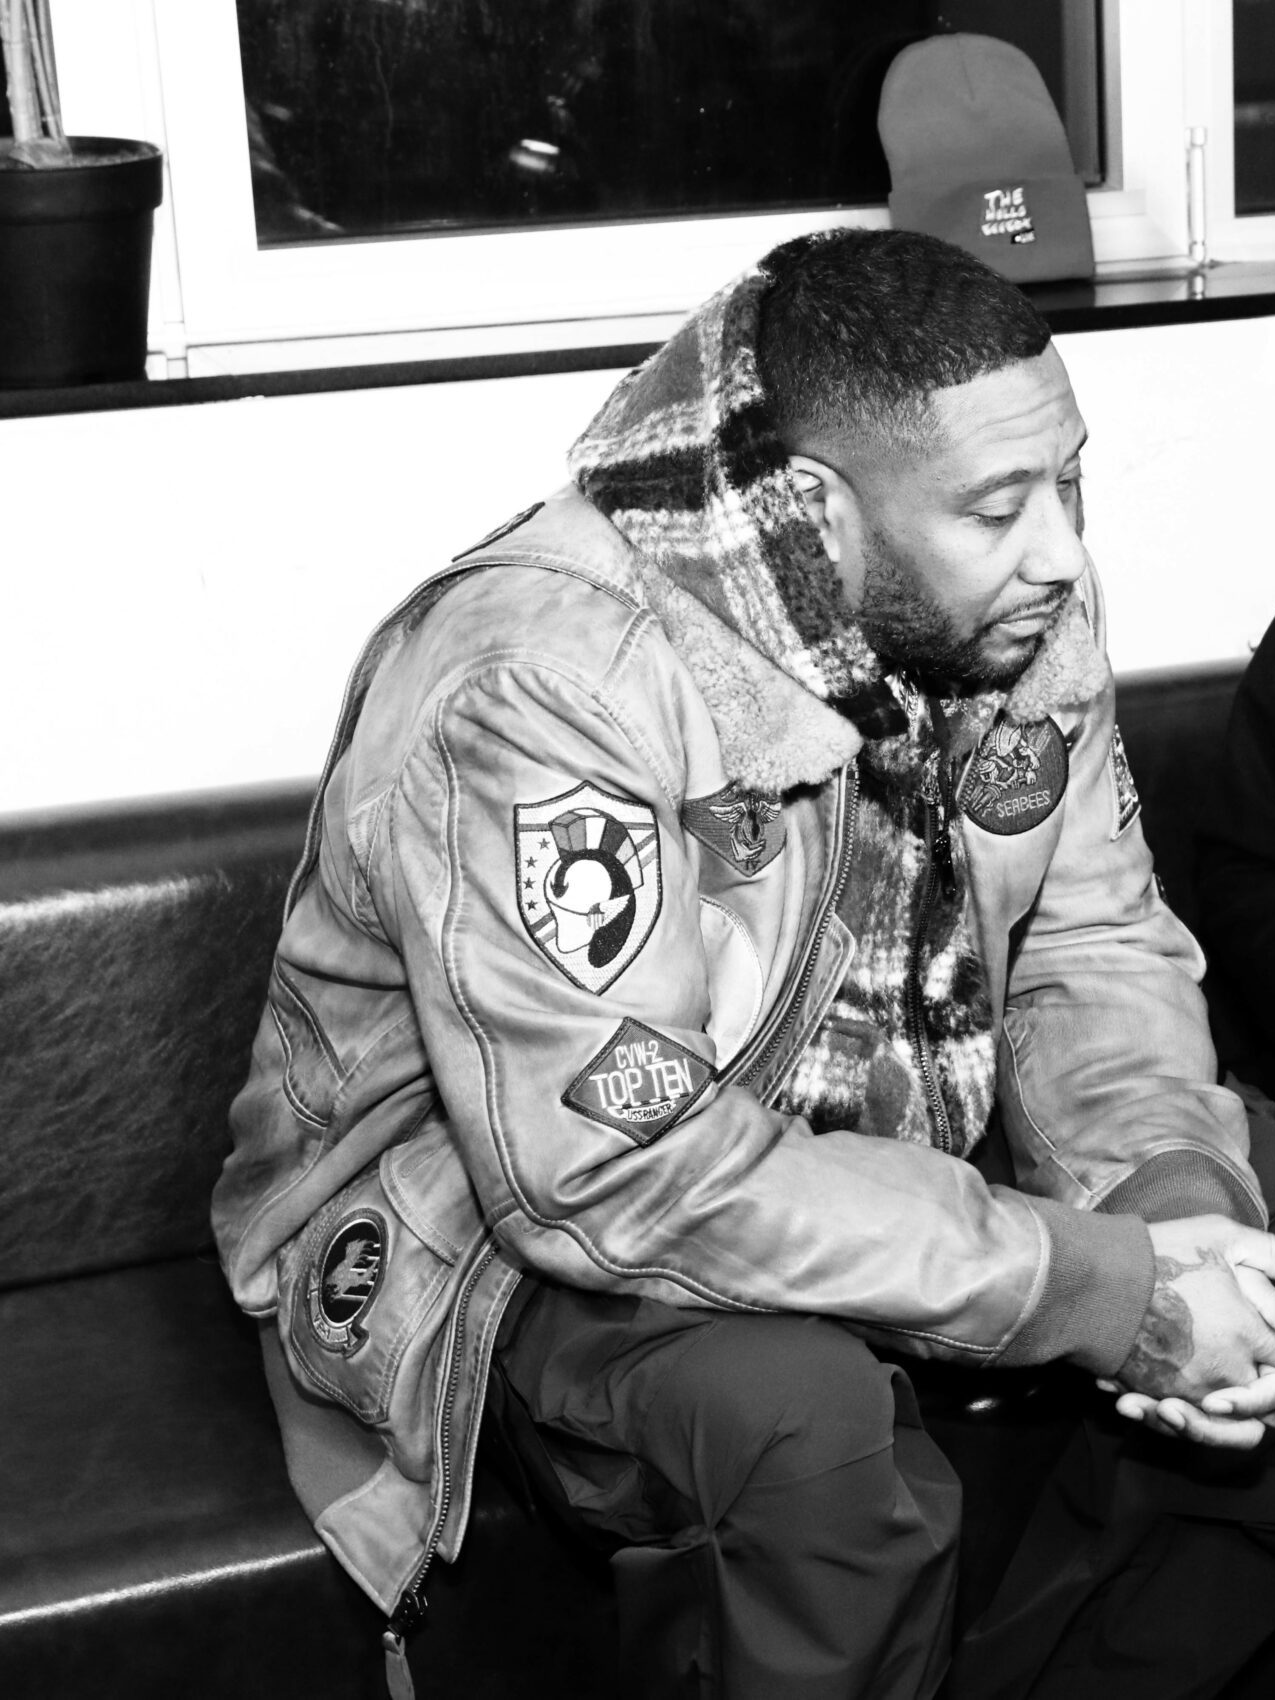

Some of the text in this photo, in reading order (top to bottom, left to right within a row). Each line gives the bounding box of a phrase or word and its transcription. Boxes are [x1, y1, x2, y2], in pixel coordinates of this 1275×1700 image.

[984, 187, 1024, 208] THE
[996, 789, 1051, 818] SEABEES
[614, 1040, 663, 1069] CVW-2
[589, 1058, 694, 1109] TOP TEN
